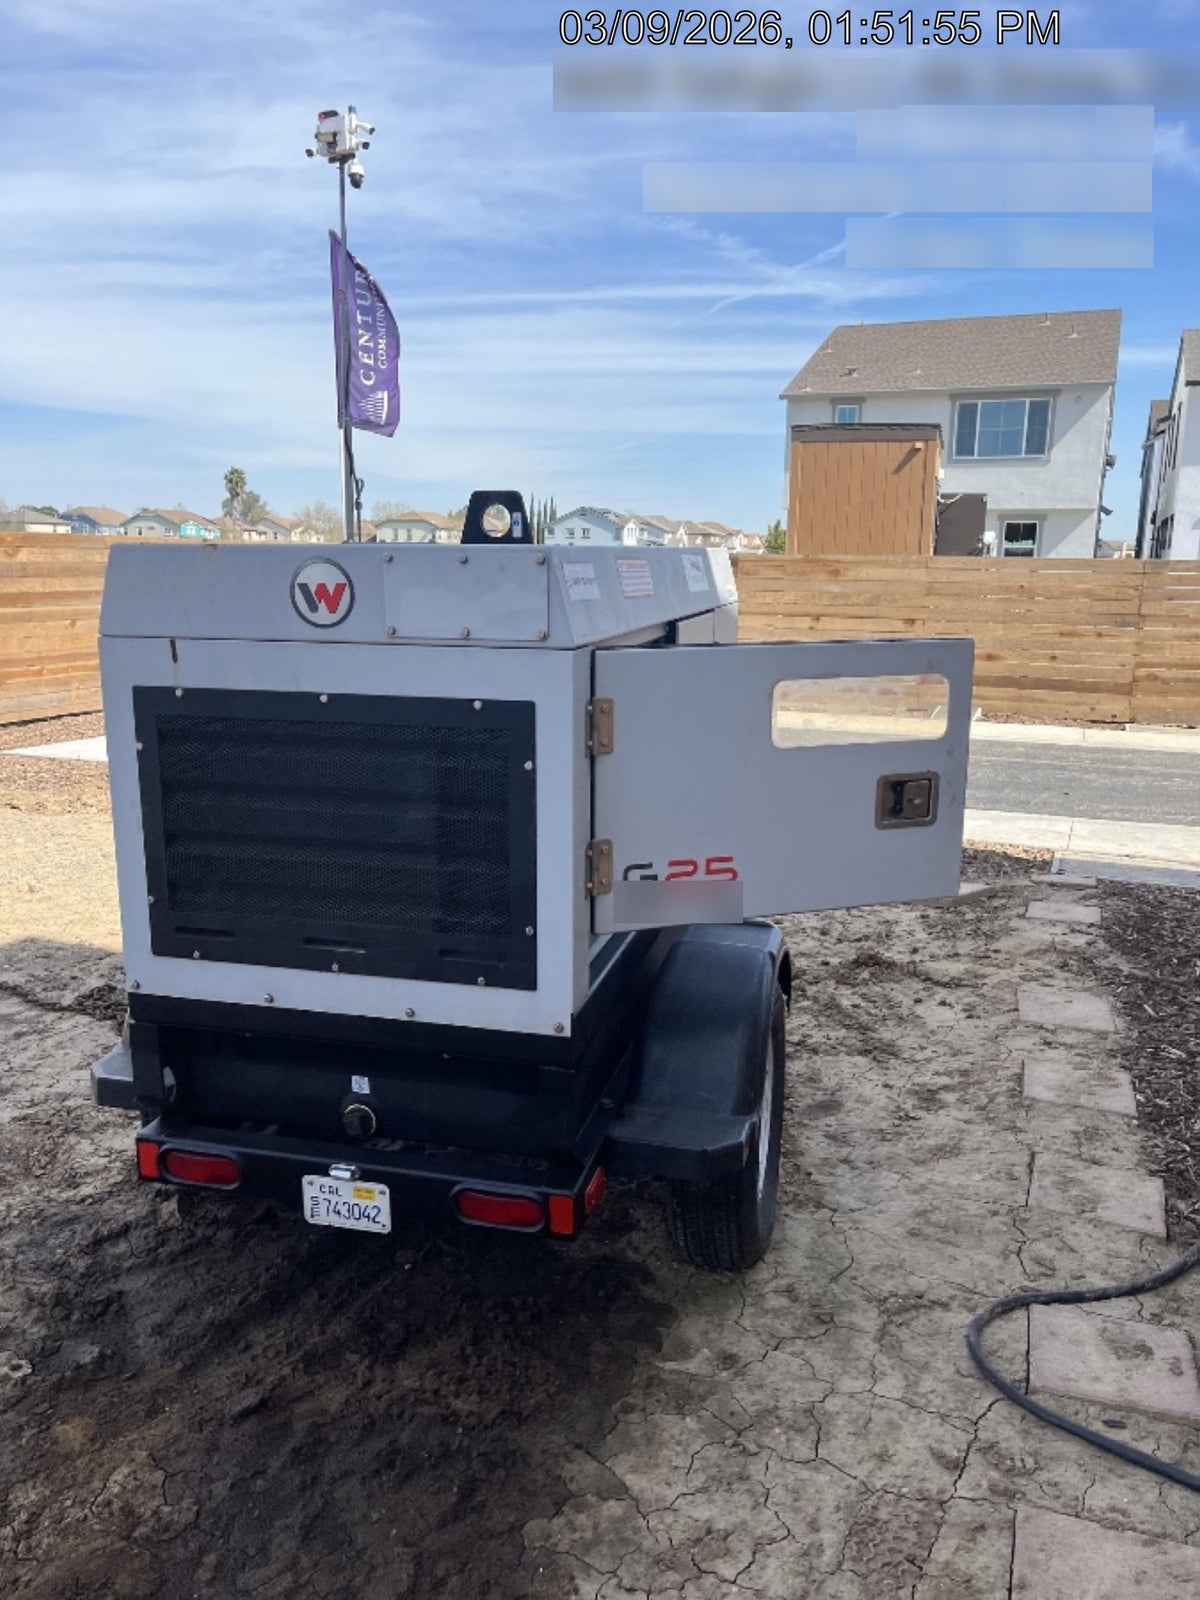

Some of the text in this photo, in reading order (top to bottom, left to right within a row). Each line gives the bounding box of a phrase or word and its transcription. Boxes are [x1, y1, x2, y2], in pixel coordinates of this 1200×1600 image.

[354, 269, 376, 386] CENTUR
[296, 582, 347, 614] W
[320, 1184, 343, 1197] CAL
[322, 1198, 382, 1224] 743042
